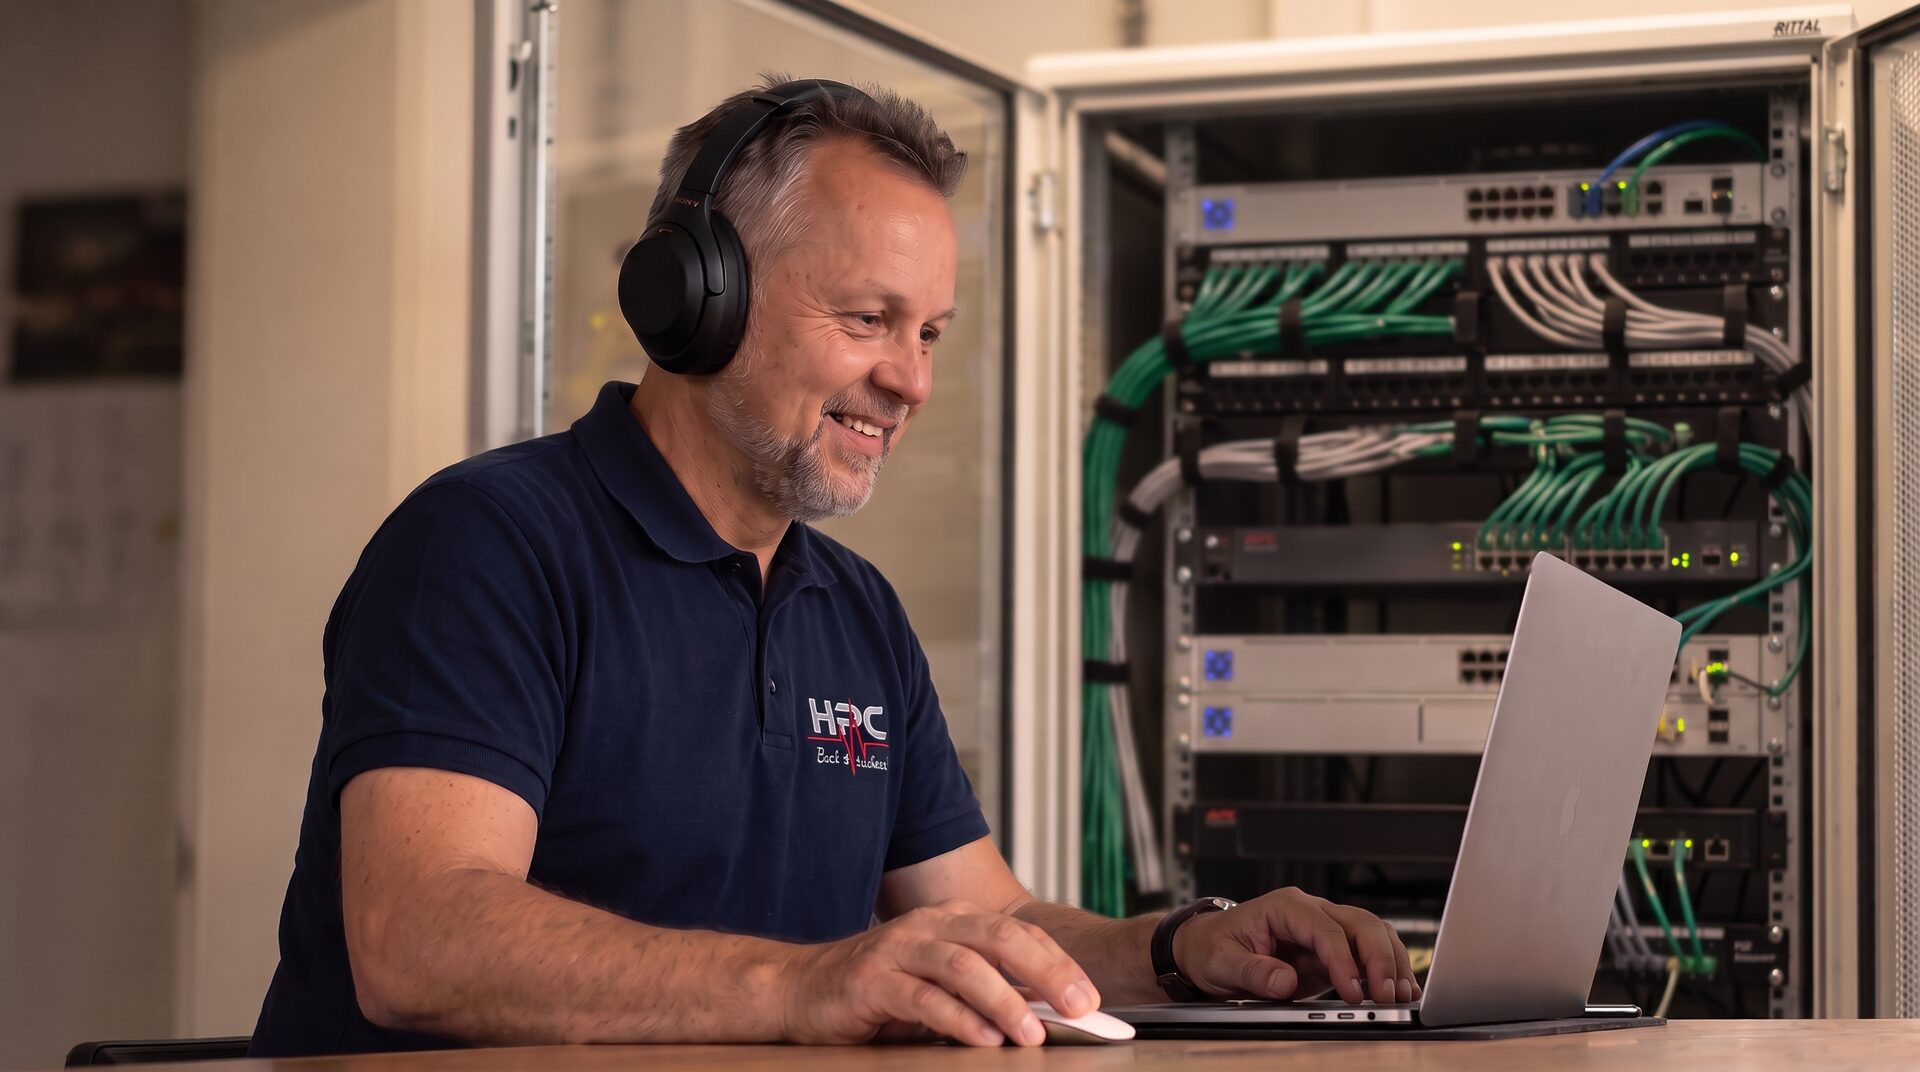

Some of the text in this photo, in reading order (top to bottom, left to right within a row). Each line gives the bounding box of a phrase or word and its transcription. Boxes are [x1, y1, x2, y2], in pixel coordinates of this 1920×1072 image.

[1773, 19, 1822, 36] RITTAL
[808, 698, 887, 740] HPC
[817, 746, 841, 764] Back
